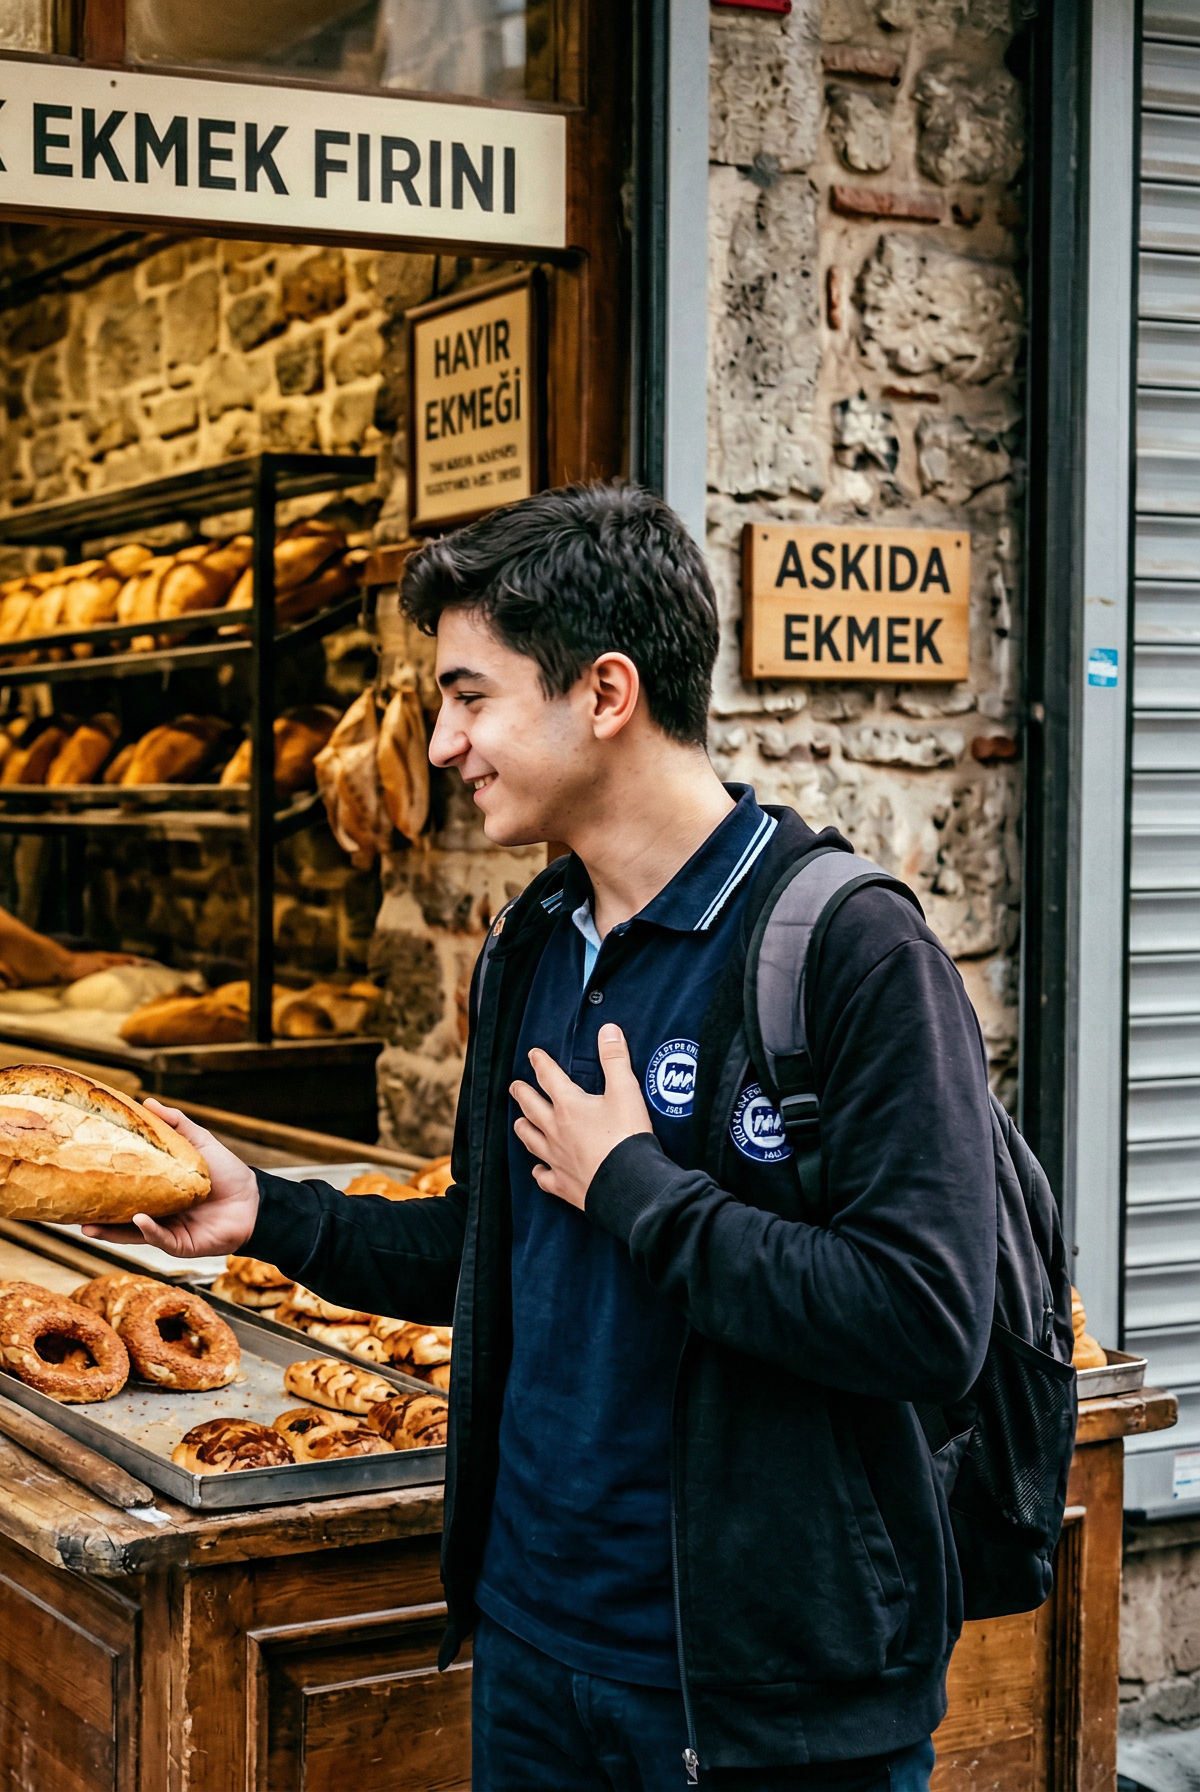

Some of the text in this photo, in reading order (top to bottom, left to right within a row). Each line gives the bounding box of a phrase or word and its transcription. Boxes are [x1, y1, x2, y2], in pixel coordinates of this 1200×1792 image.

[32, 102, 291, 196] EKMEK
[314, 129, 516, 215] FIRINI
[433, 317, 511, 379] HAYIR
[424, 367, 522, 442] EKMEĞİ
[775, 540, 951, 594] ASKIDA
[784, 613, 943, 663] EKMEK
